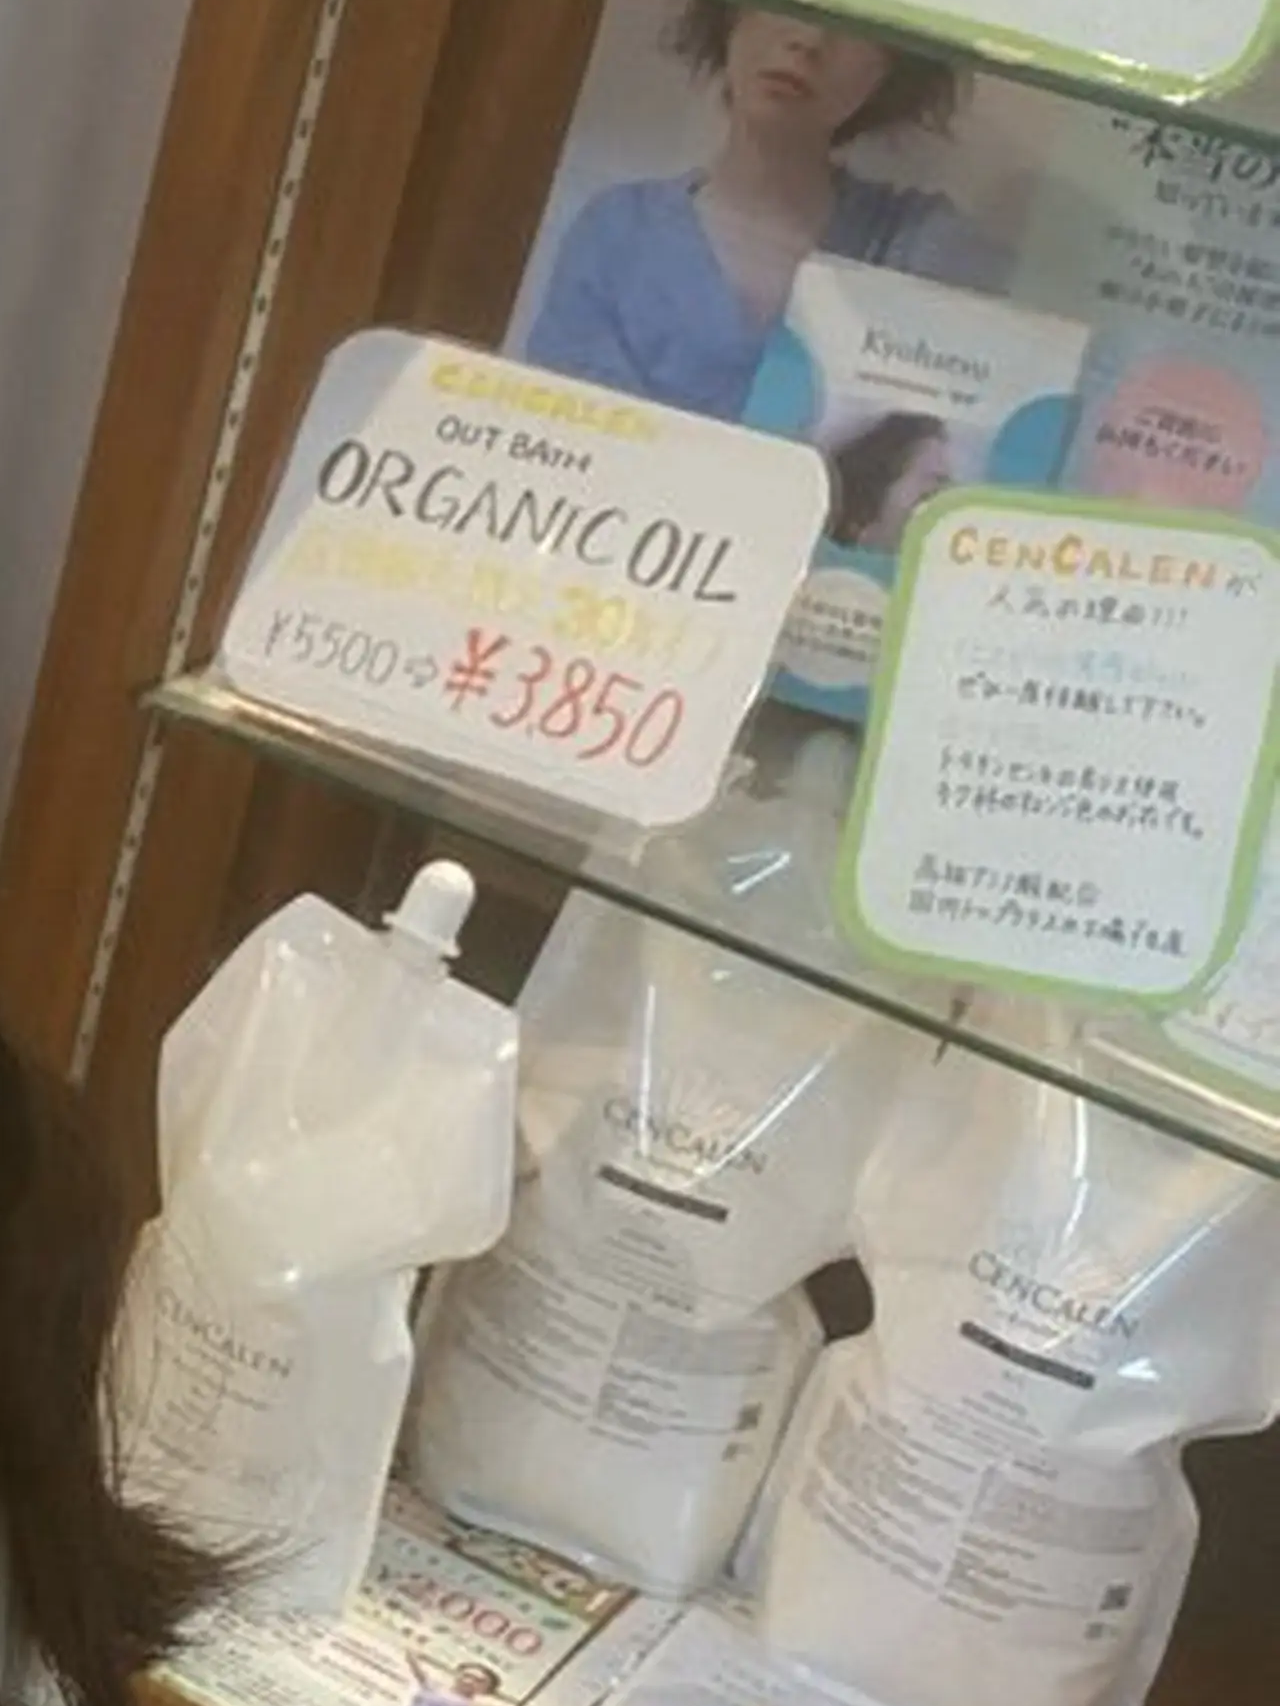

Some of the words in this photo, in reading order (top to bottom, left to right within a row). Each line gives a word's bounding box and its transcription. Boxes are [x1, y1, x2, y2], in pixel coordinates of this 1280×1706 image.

[435, 414, 503, 452] OUT
[507, 430, 593, 474] BATH
[316, 436, 630, 570] ORGANIC
[626, 515, 738, 603] OIL
[264, 608, 401, 687] ¥5500
